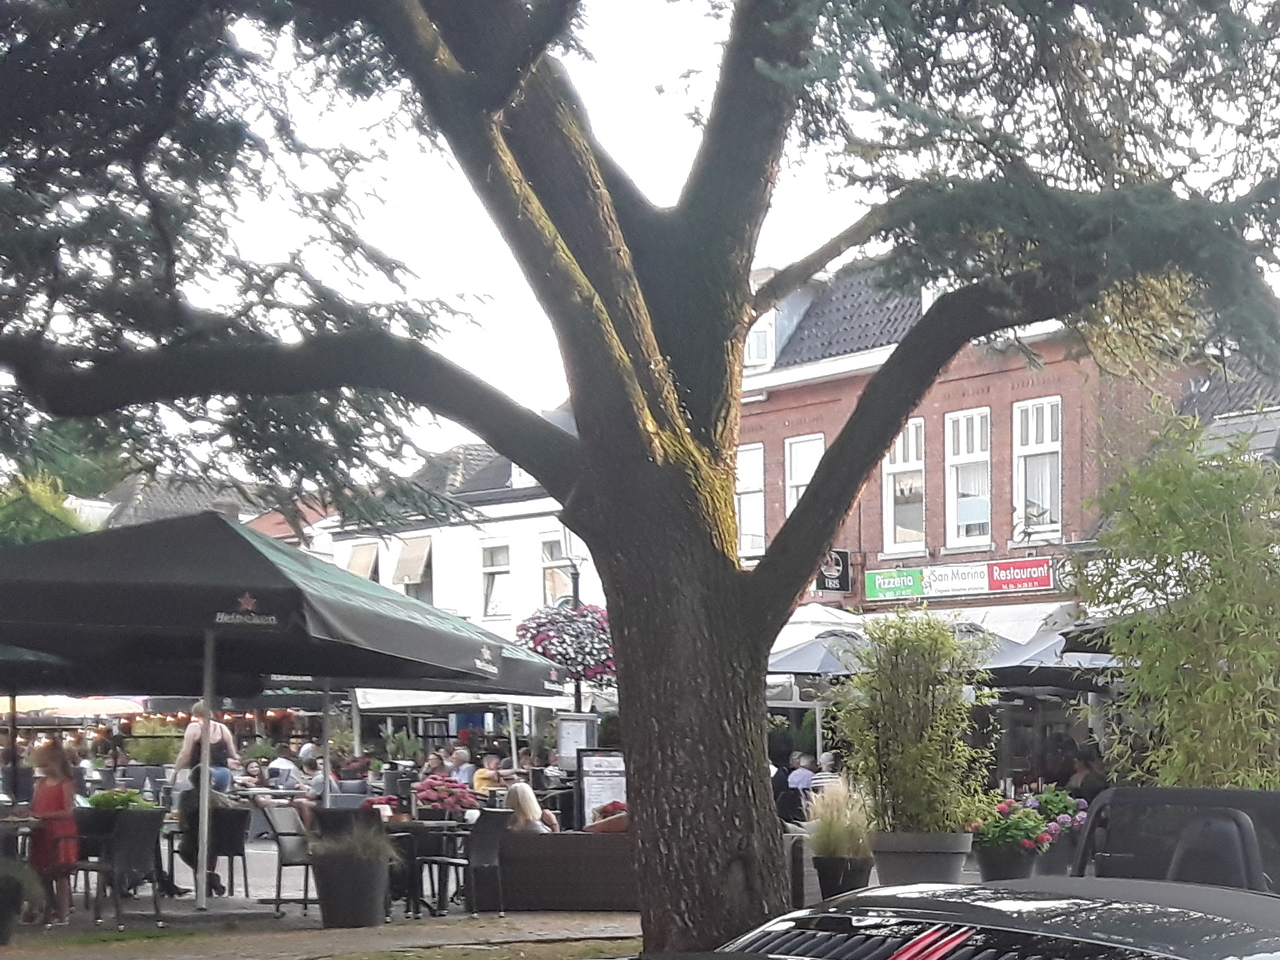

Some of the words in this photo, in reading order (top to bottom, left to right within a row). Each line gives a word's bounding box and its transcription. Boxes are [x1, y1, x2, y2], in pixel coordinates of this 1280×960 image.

[931, 569, 949, 582] San
[950, 567, 986, 582] Marino
[993, 564, 1048, 581] Restaurant
[875, 573, 914, 589] Pizzeria
